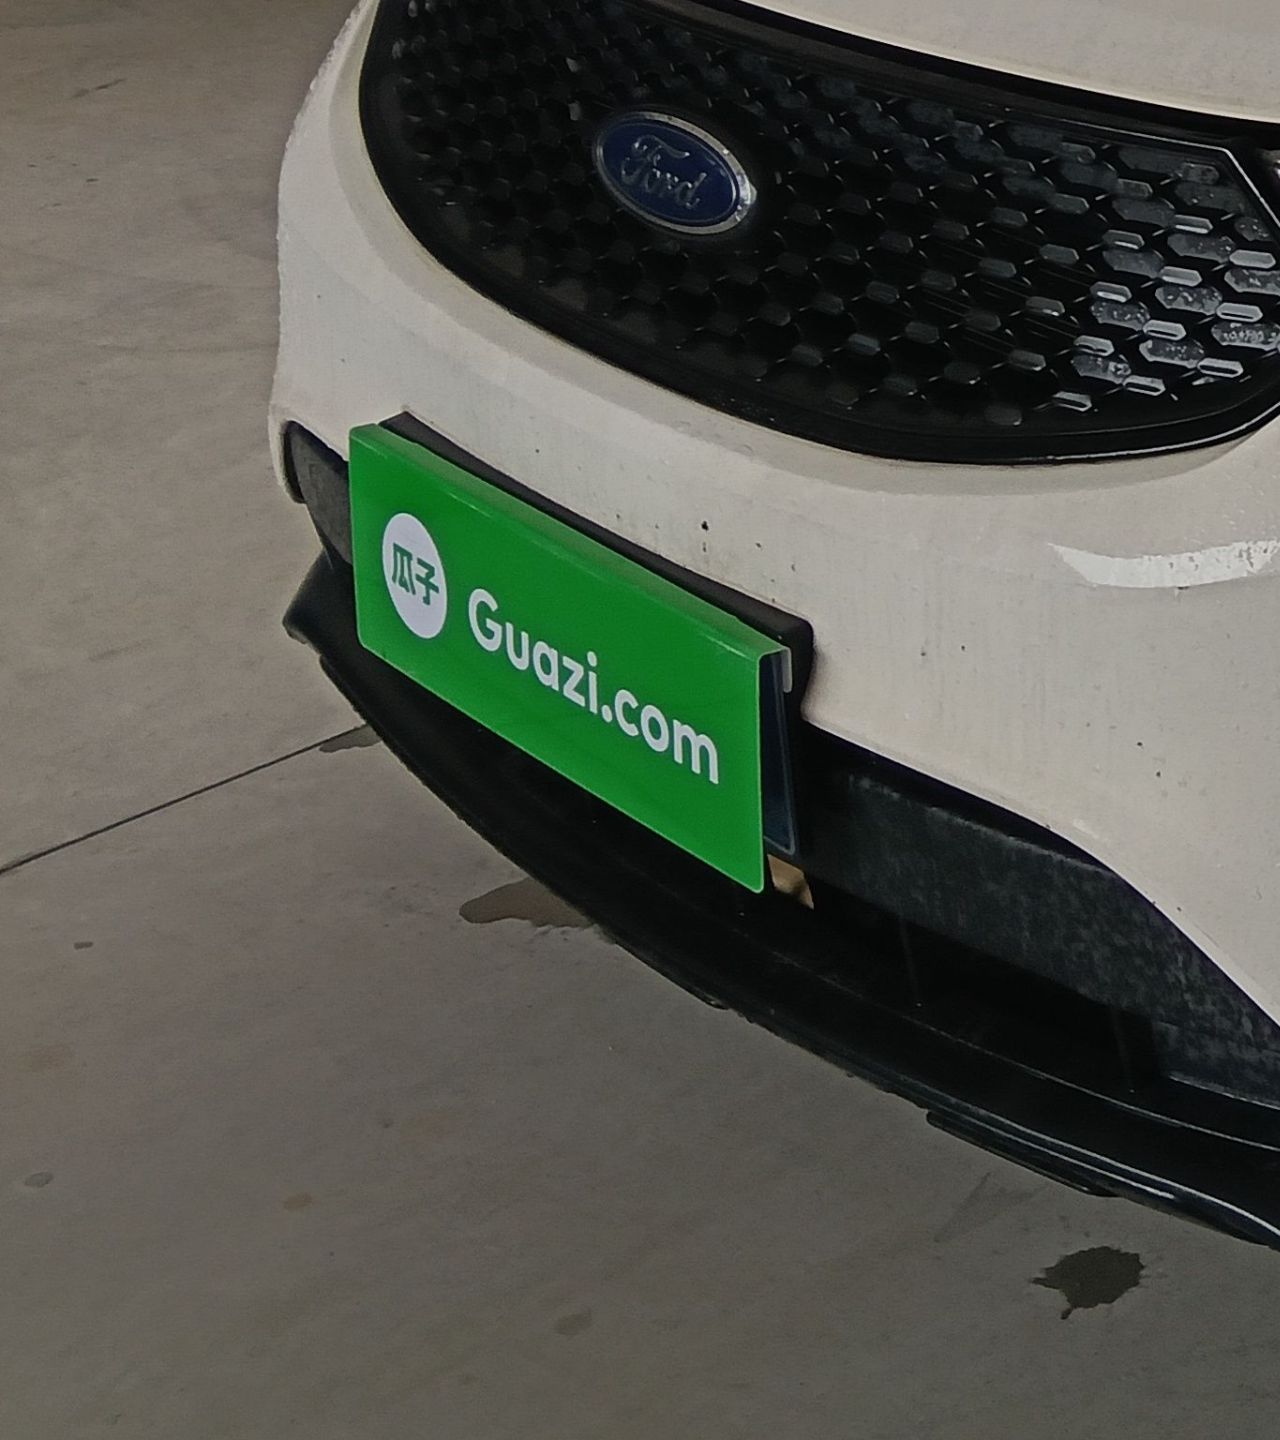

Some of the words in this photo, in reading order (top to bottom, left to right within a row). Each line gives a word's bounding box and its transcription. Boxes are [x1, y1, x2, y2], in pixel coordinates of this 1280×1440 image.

[620, 134, 708, 210] Ford
[391, 542, 440, 606] 瓜子
[468, 588, 720, 785] Guazi.com
